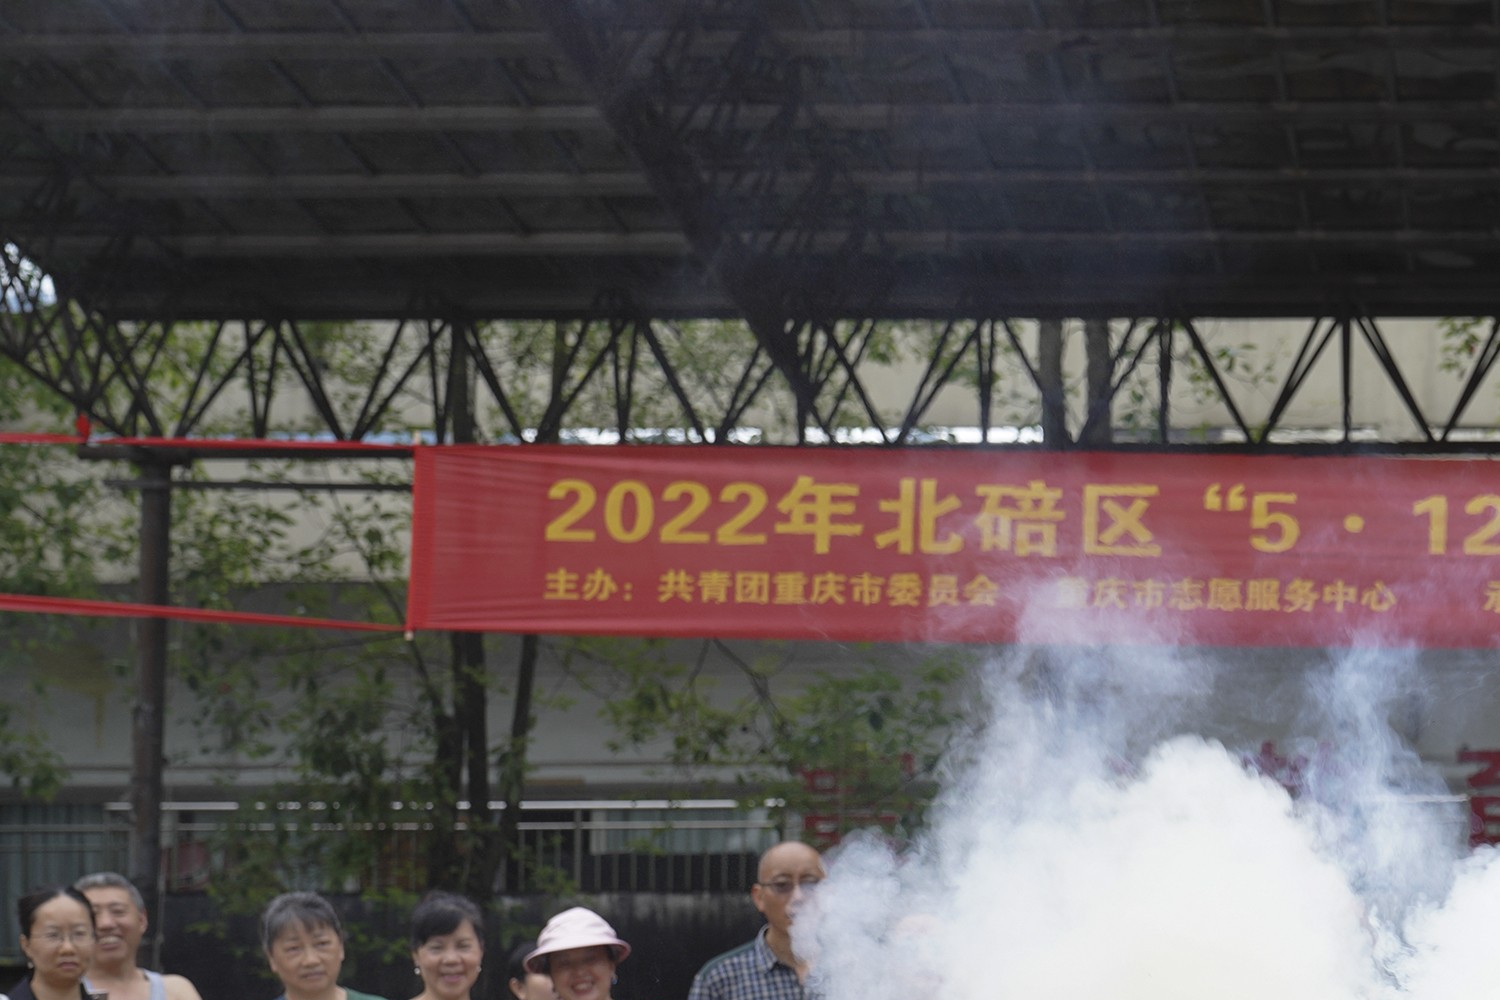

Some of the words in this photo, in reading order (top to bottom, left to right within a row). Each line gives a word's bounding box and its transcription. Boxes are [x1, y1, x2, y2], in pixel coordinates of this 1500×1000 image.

[1057, 576, 1398, 613] 重庆市志愿服务中心
